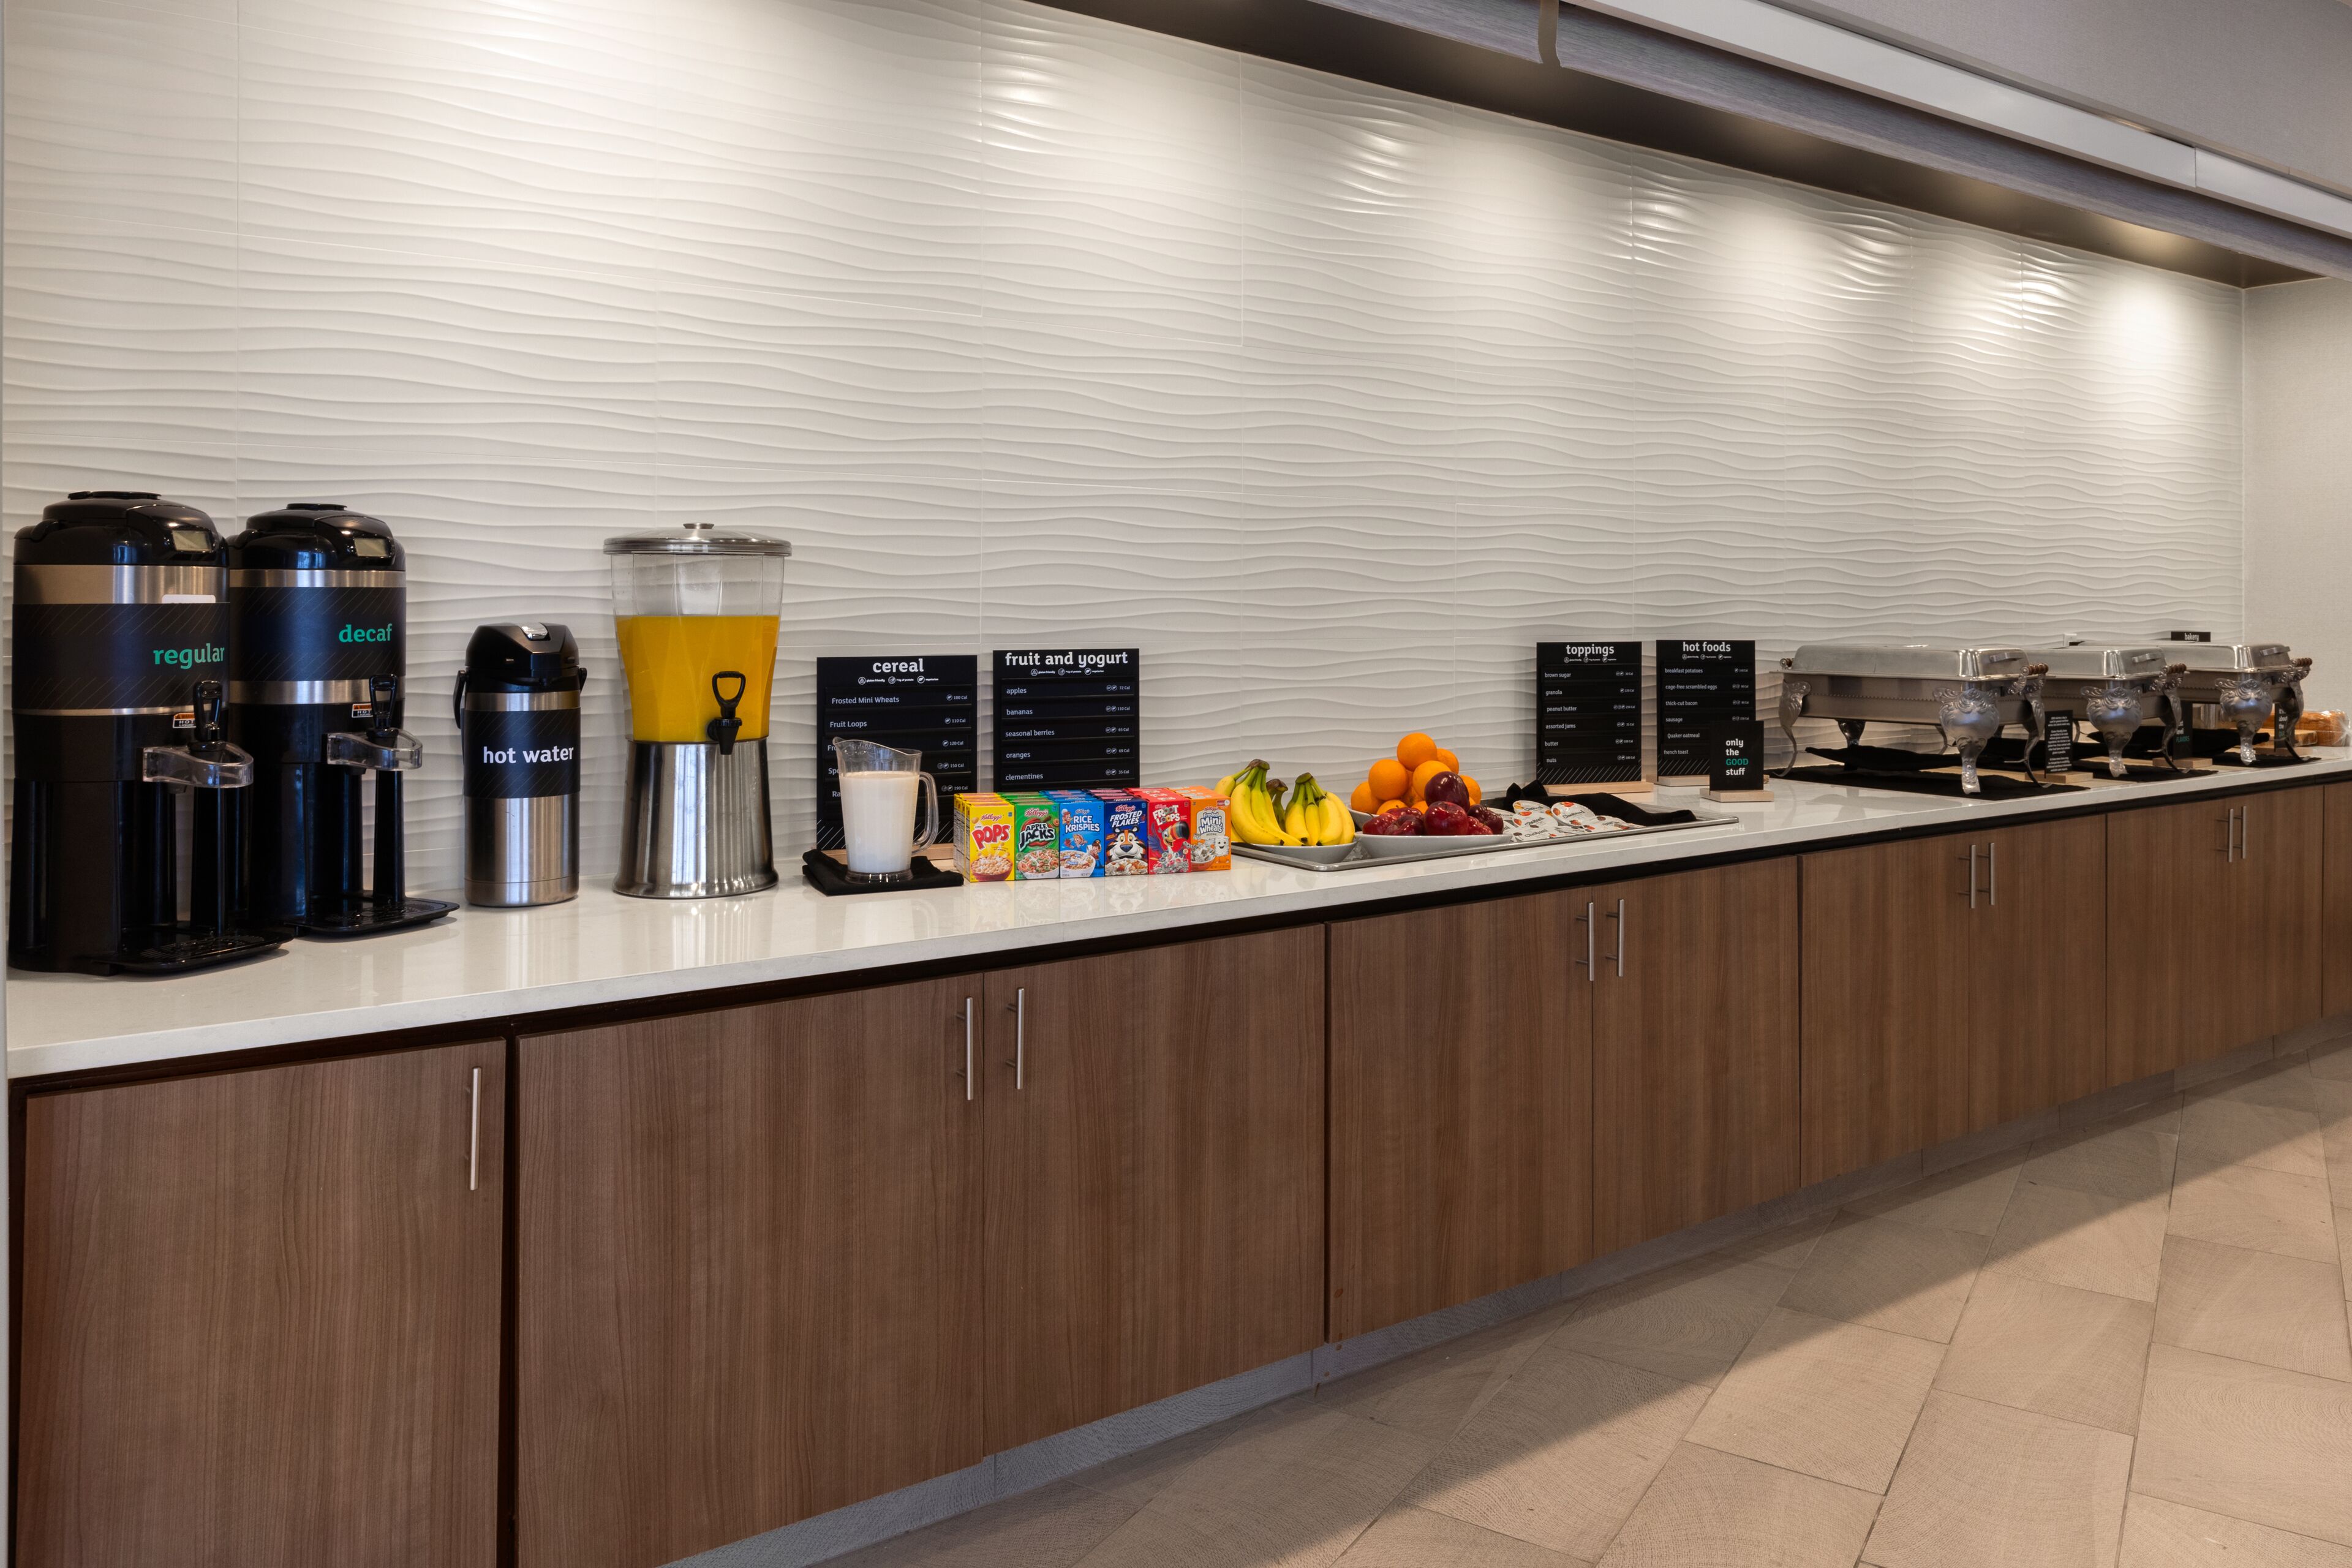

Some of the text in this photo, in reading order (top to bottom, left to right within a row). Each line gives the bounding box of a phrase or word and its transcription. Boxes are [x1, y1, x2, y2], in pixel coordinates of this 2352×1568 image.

[339, 623, 393, 643] decaf
[2185, 633, 2199, 642] bakery
[1566, 644, 1615, 657] toppings
[1683, 641, 1731, 652] hot foods
[153, 643, 224, 669] regular
[1005, 652, 1128, 668] fruit and yogurt
[873, 658, 924, 673] cereal
[1725, 738, 1744, 748] only
[483, 745, 574, 764] hot water
[1110, 810, 1142, 822] FROSTED
[1153, 805, 1178, 820] FROOT
[1073, 815, 1093, 824] RICE
[1112, 817, 1139, 828] FLAKES
[1156, 813, 1180, 826] LOOPS
[1201, 817, 1221, 826] Mini
[1066, 823, 1100, 833] KRISPIES
[1199, 824, 1223, 834] Wheats
[971, 824, 1010, 850] POPS
[1019, 829, 1054, 850] JACKS
